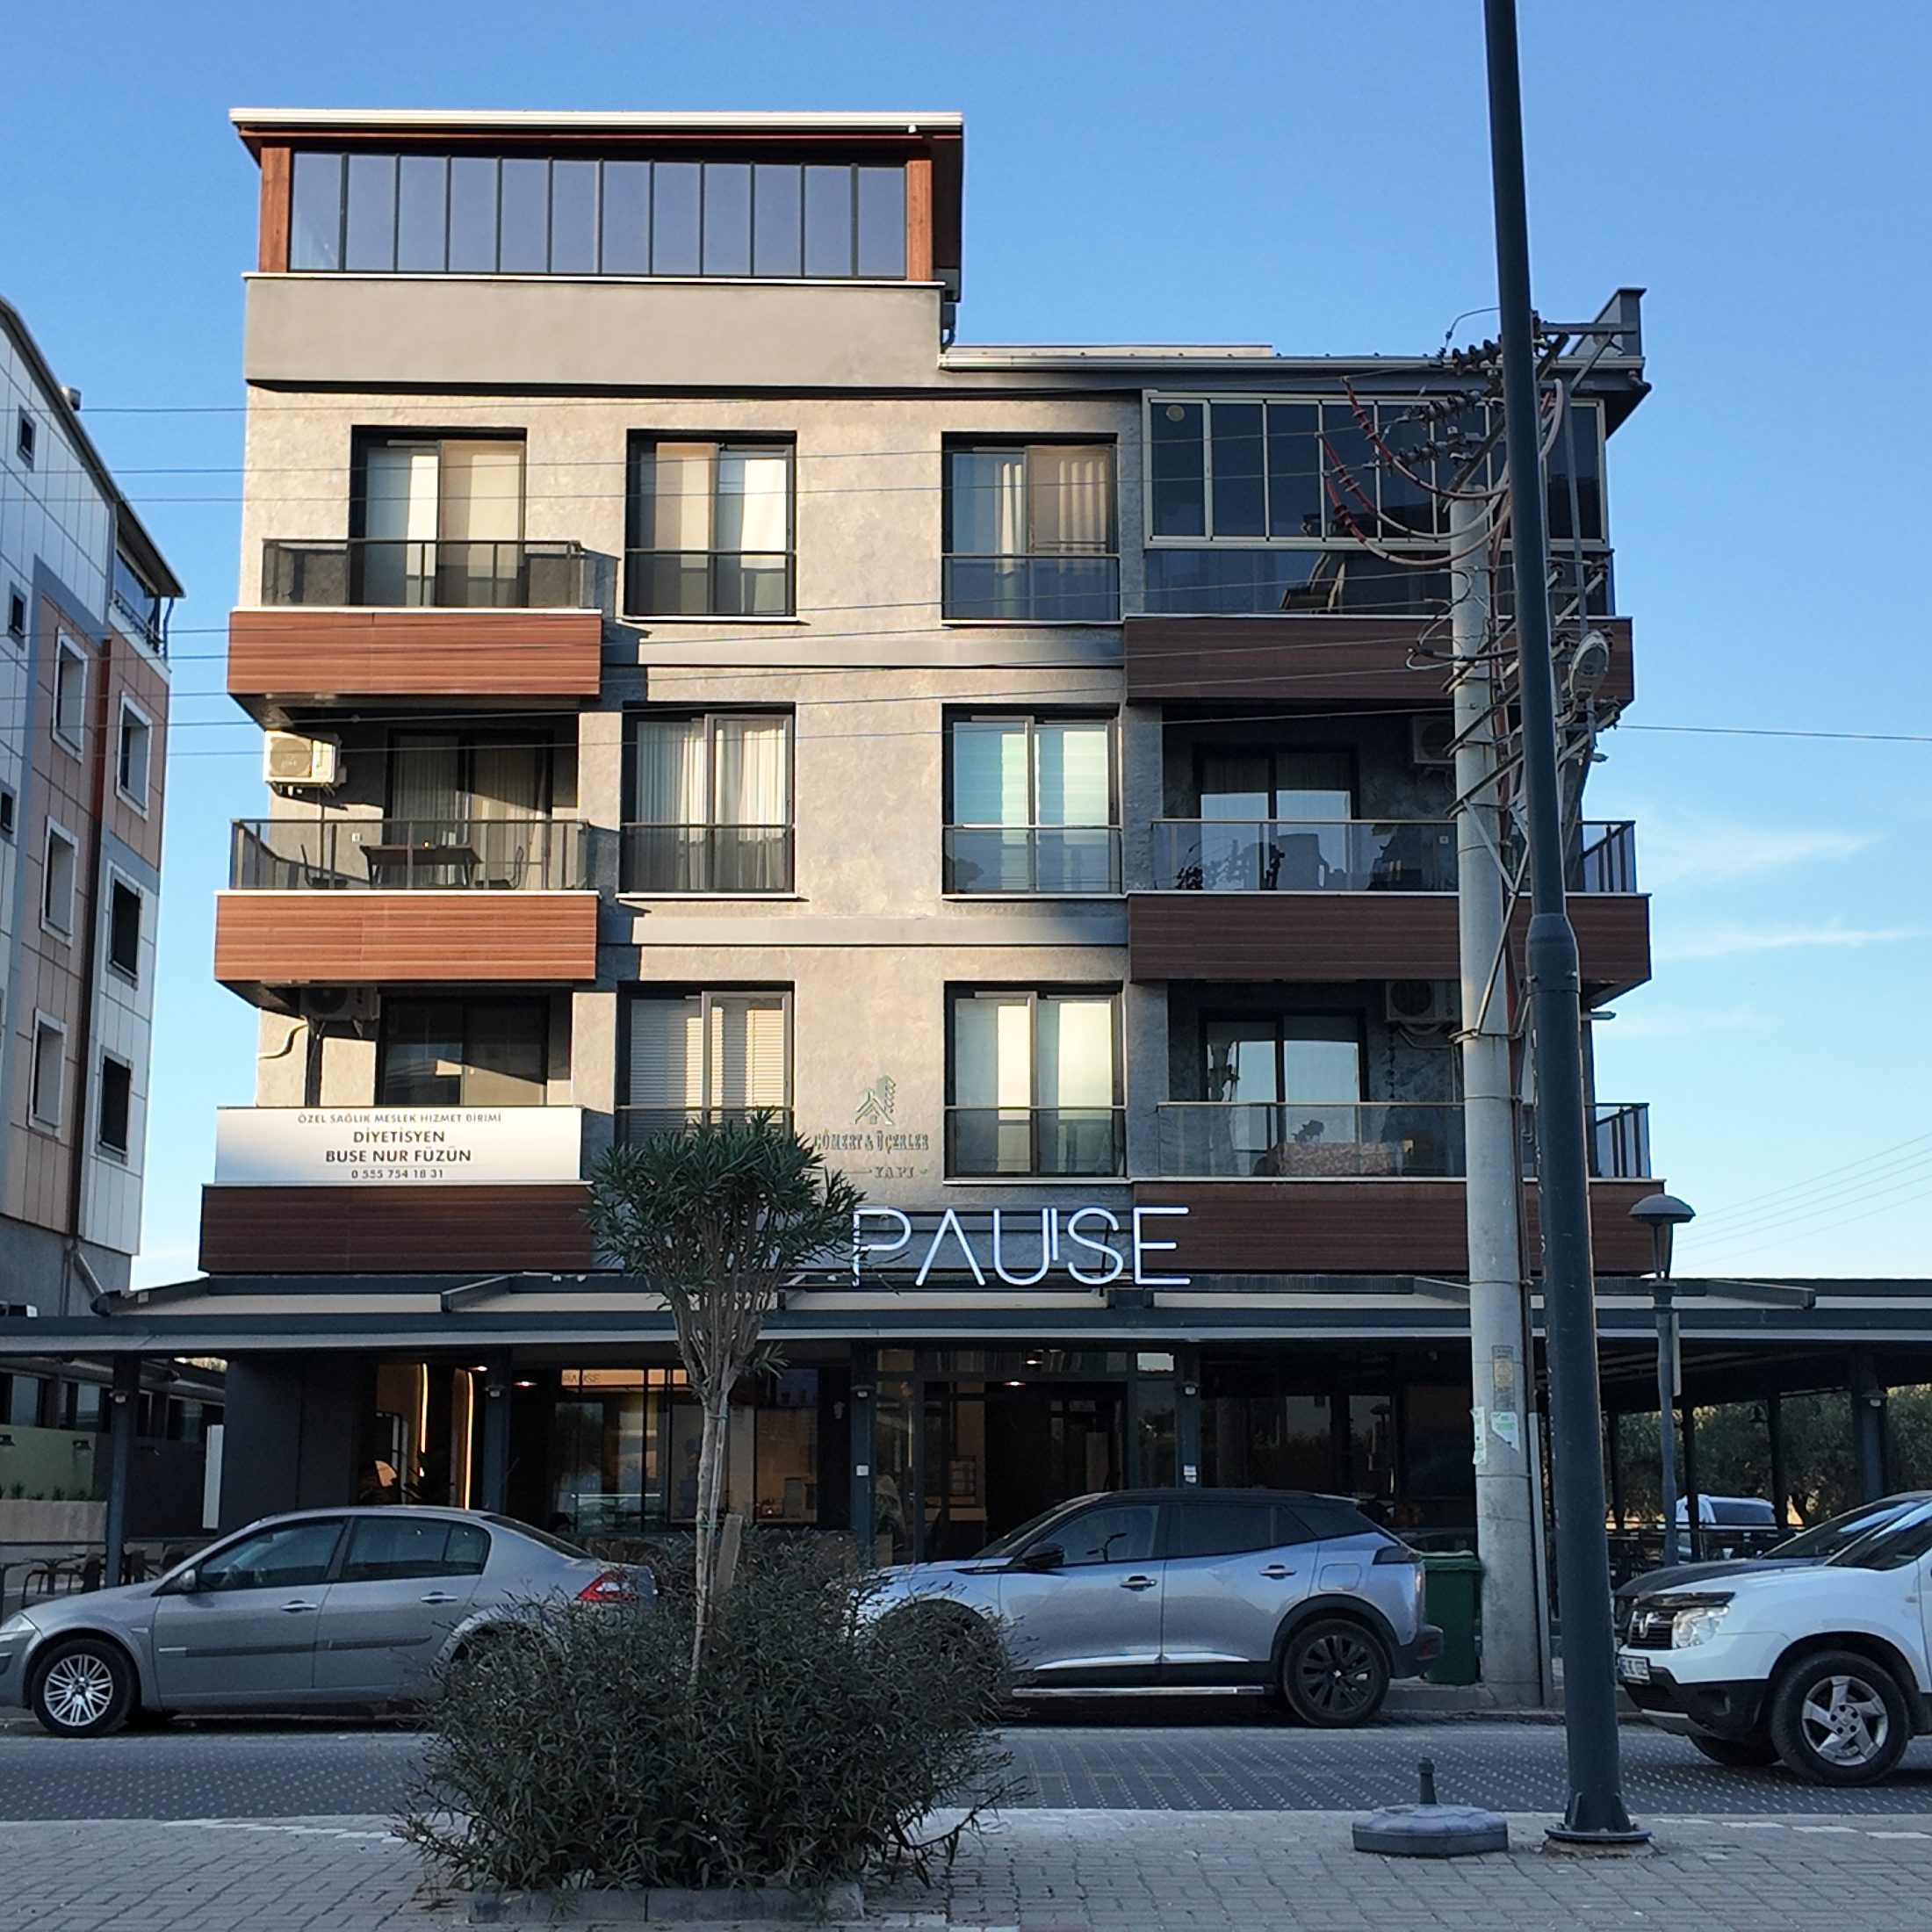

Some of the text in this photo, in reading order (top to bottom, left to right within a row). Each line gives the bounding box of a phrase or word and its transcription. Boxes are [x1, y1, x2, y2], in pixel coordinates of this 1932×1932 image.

[298, 1112, 326, 1123] ÖZEL
[374, 1114, 416, 1123] MESLEK
[353, 1127, 445, 1143] DİYETİSYEN
[865, 1134, 874, 1150] &
[326, 1146, 472, 1163] BUSE NUR FÜZÜN
[351, 1169, 358, 1179] 0
[430, 1169, 443, 1179] 31
[852, 1207, 1191, 1286] PAUSE
